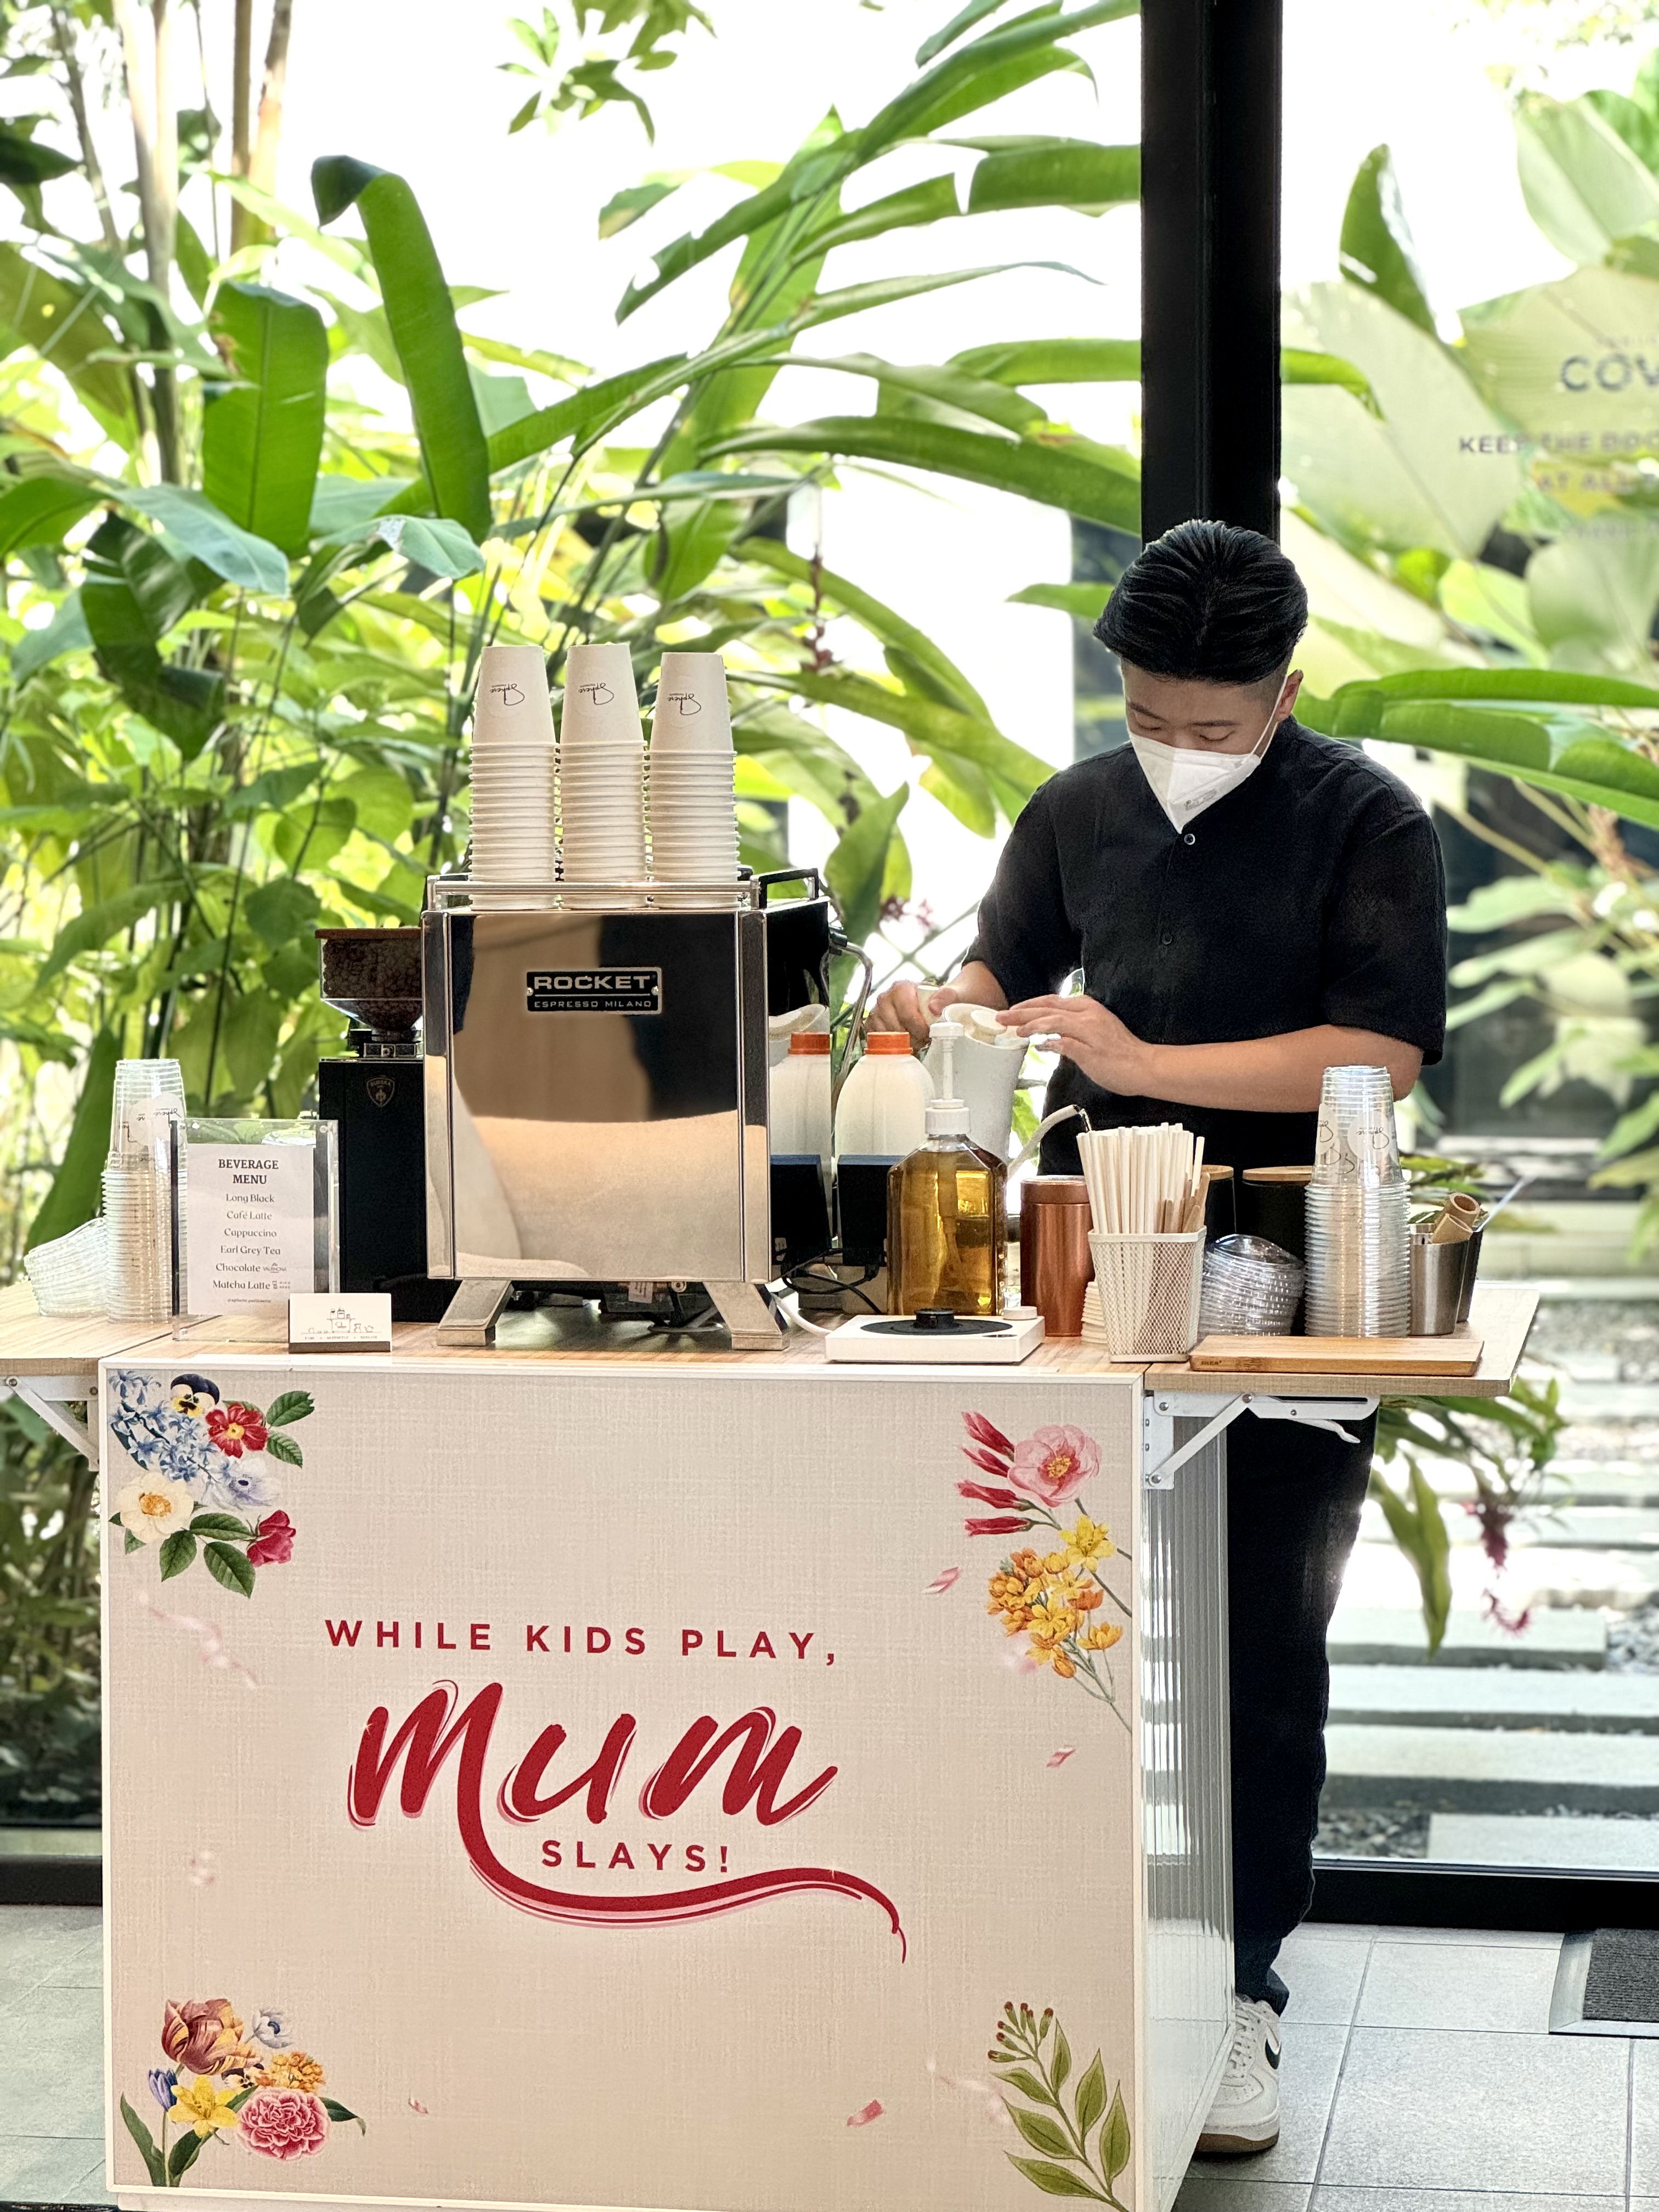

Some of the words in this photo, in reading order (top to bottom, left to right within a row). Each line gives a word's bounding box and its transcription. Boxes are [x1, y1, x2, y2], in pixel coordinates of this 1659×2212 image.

[1459, 434, 1528, 454] KEEP
[534, 975, 650, 989] ROCKET
[218, 1159, 279, 1170] BEVERAGE
[233, 1175, 267, 1184] MENU
[226, 1193, 249, 1204] Long
[250, 1194, 275, 1203] Black
[227, 1211, 247, 1220] Café
[250, 1211, 273, 1220] Latte
[224, 1228, 277, 1238] Cappuccino
[221, 1245, 238, 1254] Earl
[240, 1245, 262, 1256] Grey
[263, 1246, 281, 1255] Tea
[216, 1263, 261, 1272] Chocolate
[213, 1280, 246, 1289] Matcha
[247, 1281, 270, 1290] Latte
[325, 1620, 490, 1650] WHILE
[527, 1625, 646, 1655] KIDS
[682, 1629, 834, 1666] PLAY,
[542, 1839, 728, 1874] SLAYS!
